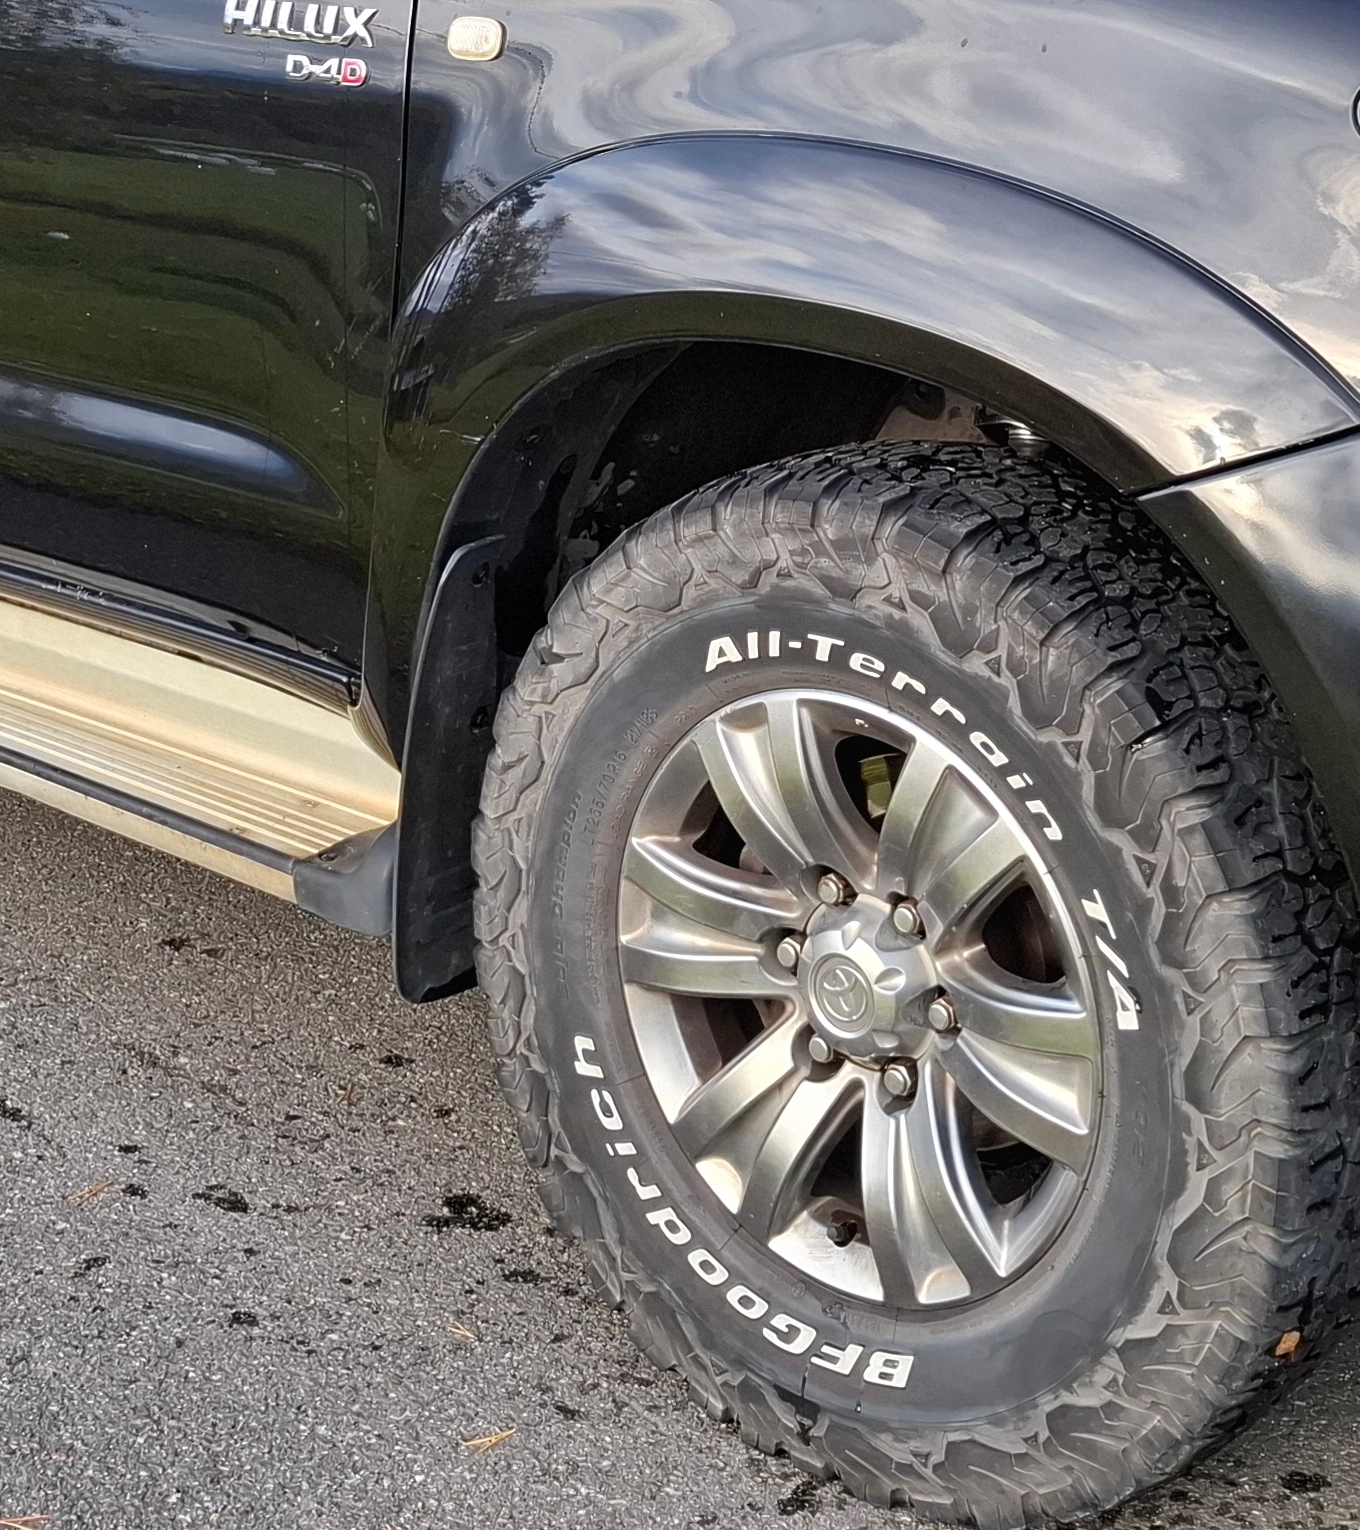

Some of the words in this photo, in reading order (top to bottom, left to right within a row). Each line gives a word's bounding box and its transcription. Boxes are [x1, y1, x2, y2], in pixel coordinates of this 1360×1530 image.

[703, 628, 1064, 843] All-Terrain
[1080, 887, 1140, 1032] T/A
[572, 1034, 916, 1391] BFGoodrich
